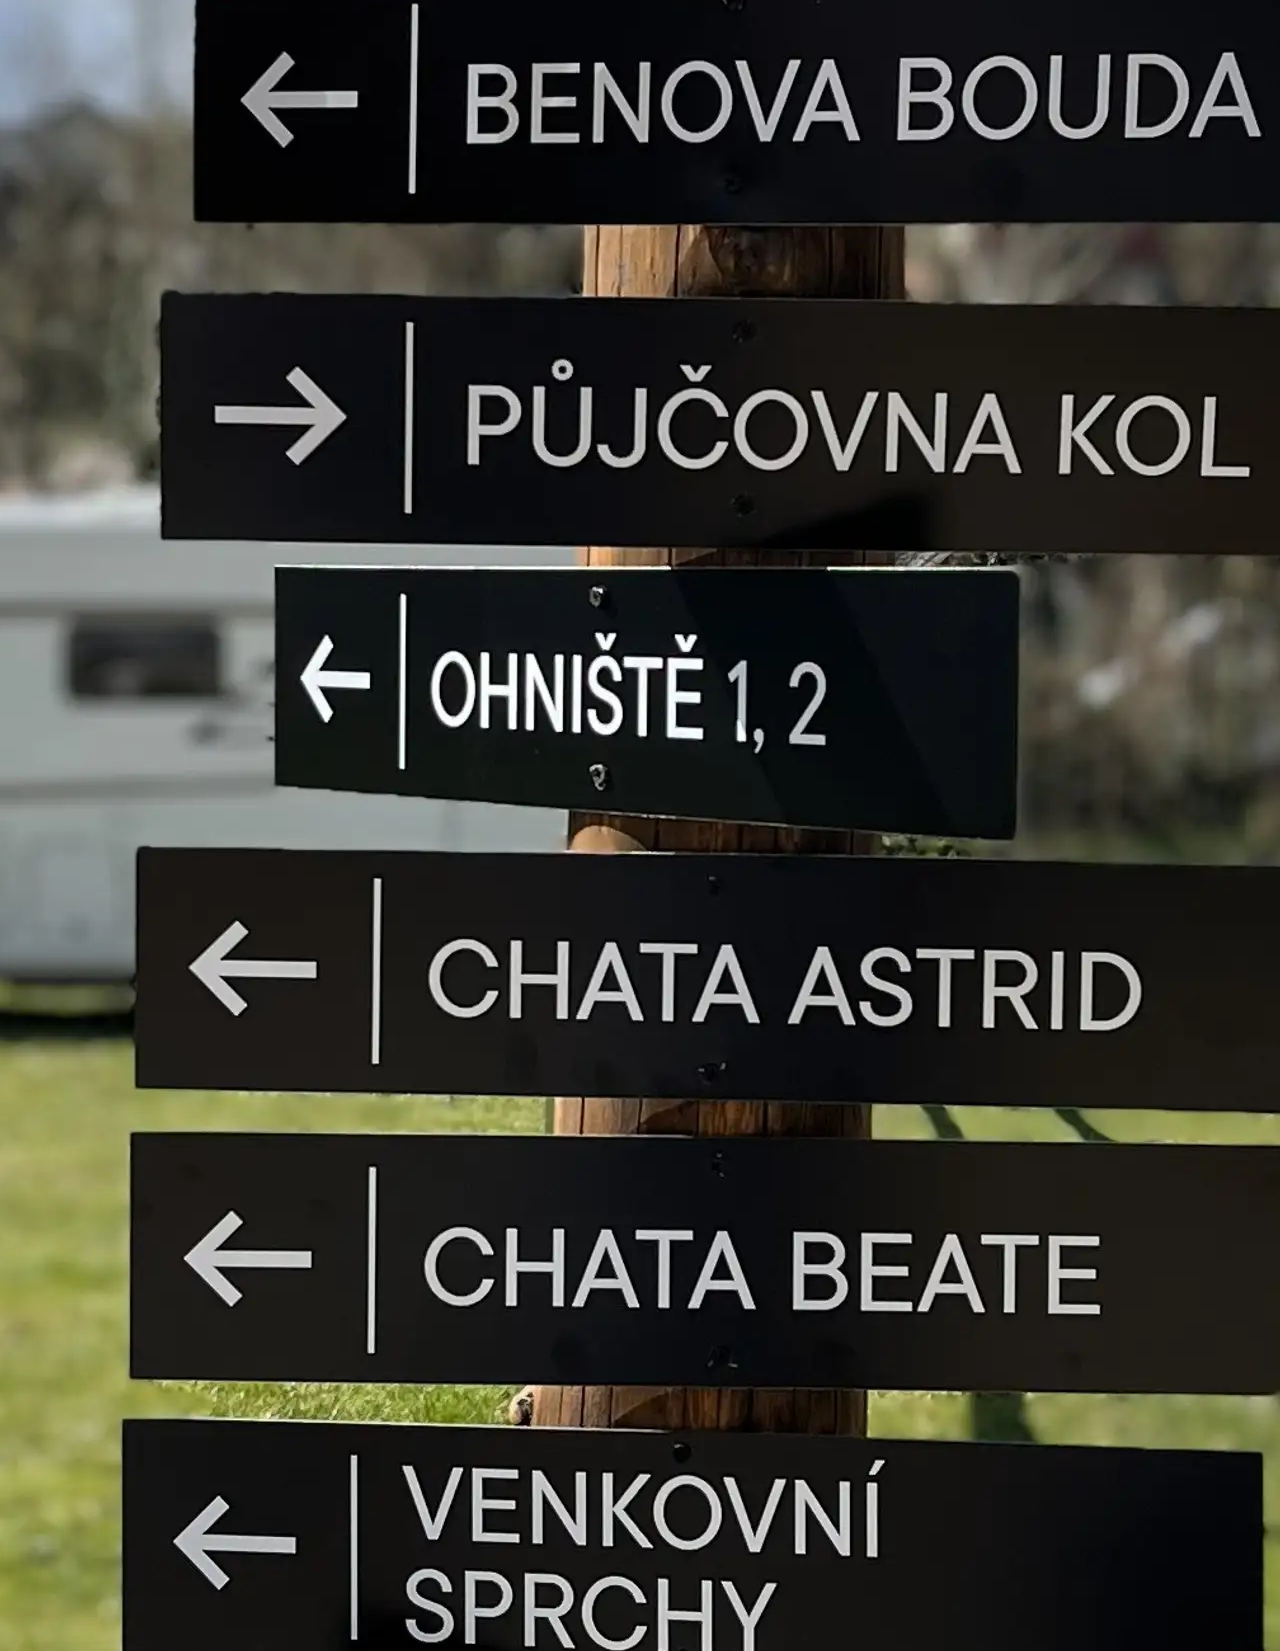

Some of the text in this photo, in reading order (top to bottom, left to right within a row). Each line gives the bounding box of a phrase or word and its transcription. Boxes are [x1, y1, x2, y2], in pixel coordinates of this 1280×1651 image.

[465, 50, 1263, 146] BENOVA BOUDA
[466, 357, 1252, 479] PŮJČOVNA KOL
[429, 631, 828, 755] OHNIŠTĚ 1, 2
[427, 937, 1143, 1032] CHATA ASTRID
[422, 1225, 1102, 1316] CHATA BEATE
[400, 1458, 887, 1559] VENKOVNÍ
